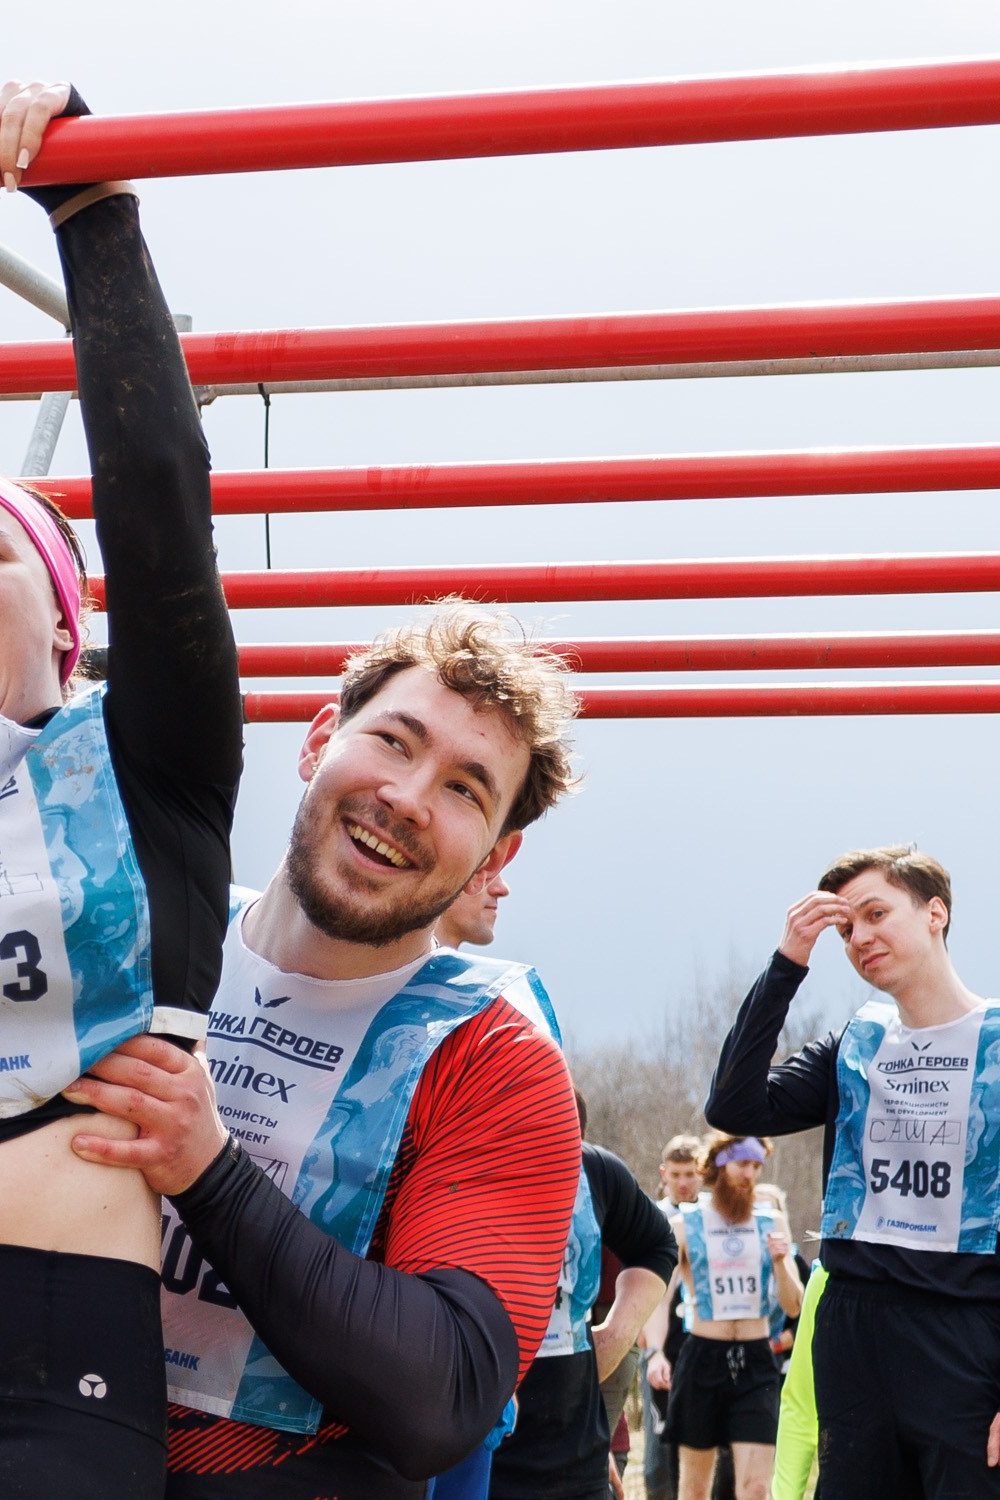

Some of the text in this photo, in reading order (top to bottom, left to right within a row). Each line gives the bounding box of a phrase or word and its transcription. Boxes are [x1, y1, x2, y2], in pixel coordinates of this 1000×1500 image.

[248, 1016, 344, 1064] ГЕРОЕВ
[878, 1056, 969, 1071] ГОНКА ГЕРОЕВ
[207, 1055, 297, 1104] minex
[883, 1077, 950, 1094] Sminex
[869, 1118, 953, 1146] САША
[870, 1158, 951, 1199] 5408
[886, 1219, 937, 1232] ГАЗПРОМБАНК
[715, 1276, 756, 1294] 5113
